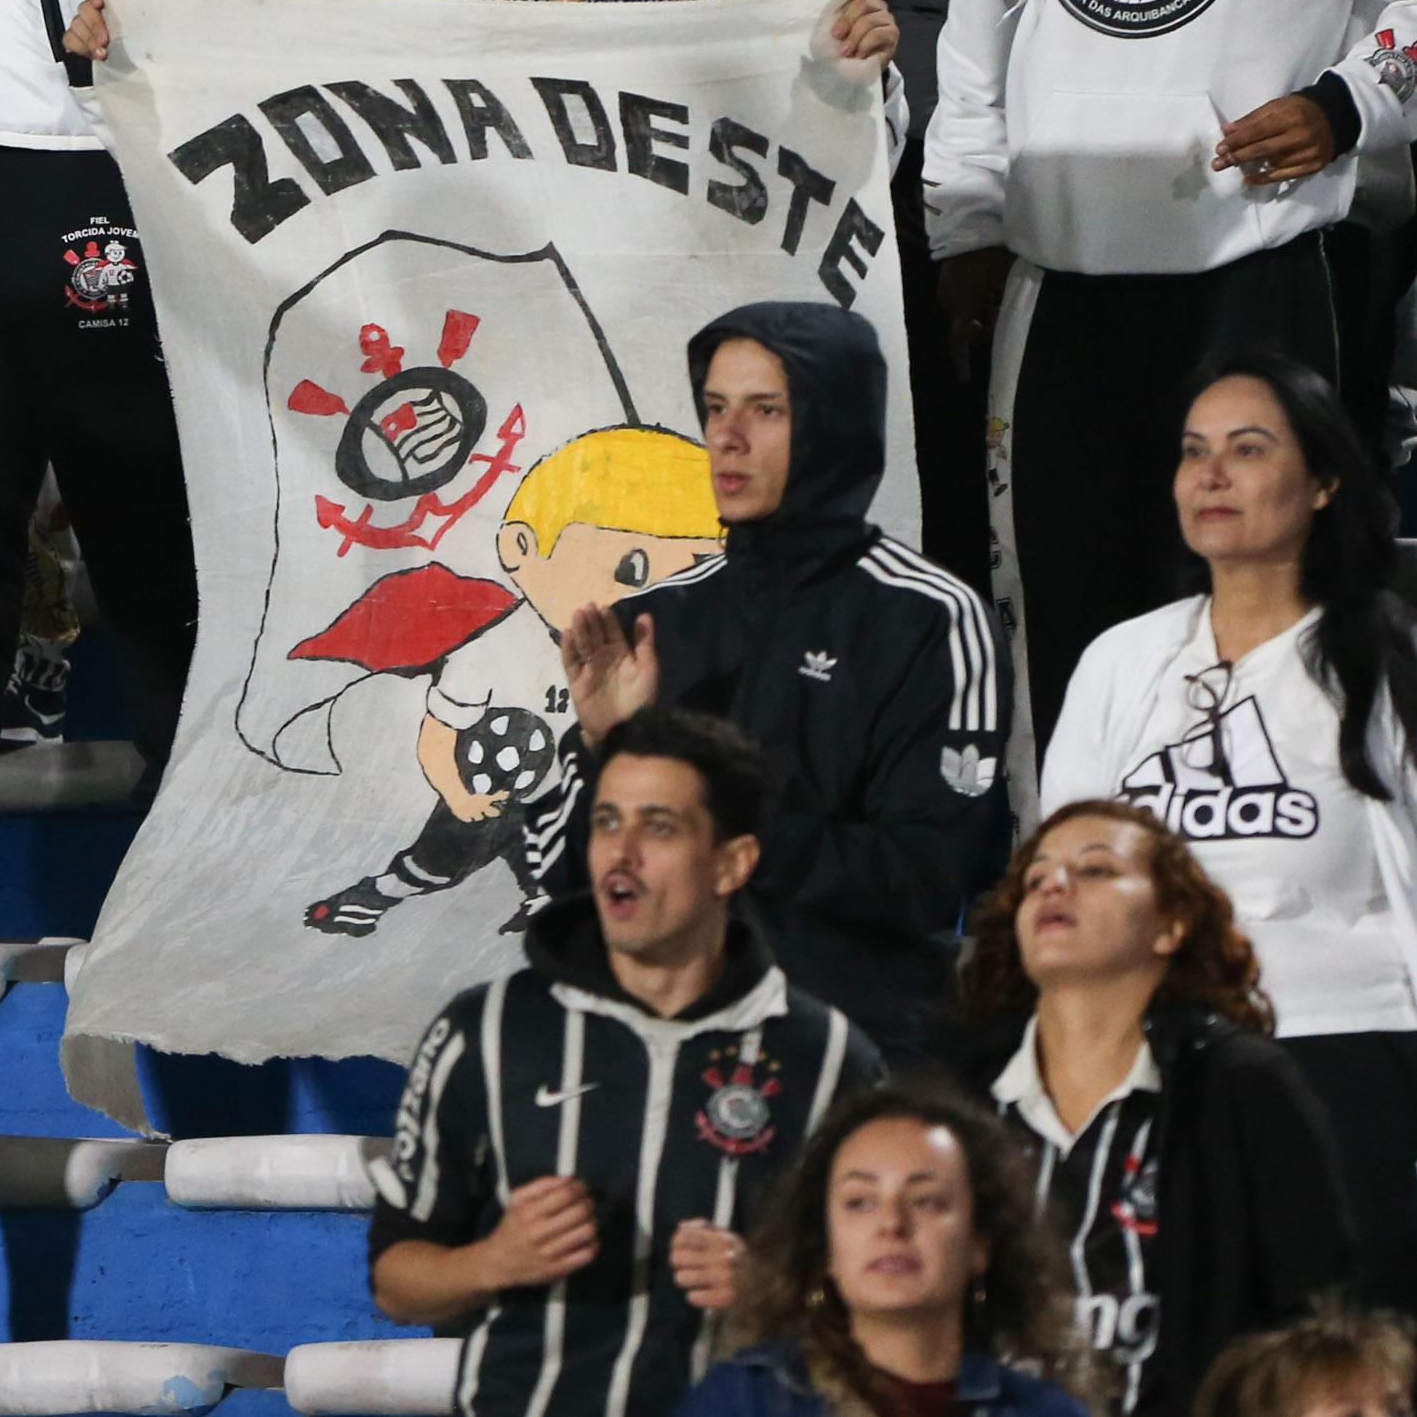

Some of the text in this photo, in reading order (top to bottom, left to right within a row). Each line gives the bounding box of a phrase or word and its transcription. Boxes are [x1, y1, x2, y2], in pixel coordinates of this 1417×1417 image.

[1089, 0, 1112, 18] DAS
[168, 77, 885, 311] ZONA DESTE
[90, 216, 110, 225] FIEL
[61, 227, 105, 243] TORCIDA
[78, 318, 129, 329] CAMISA 12
[545, 684, 569, 713] 12
